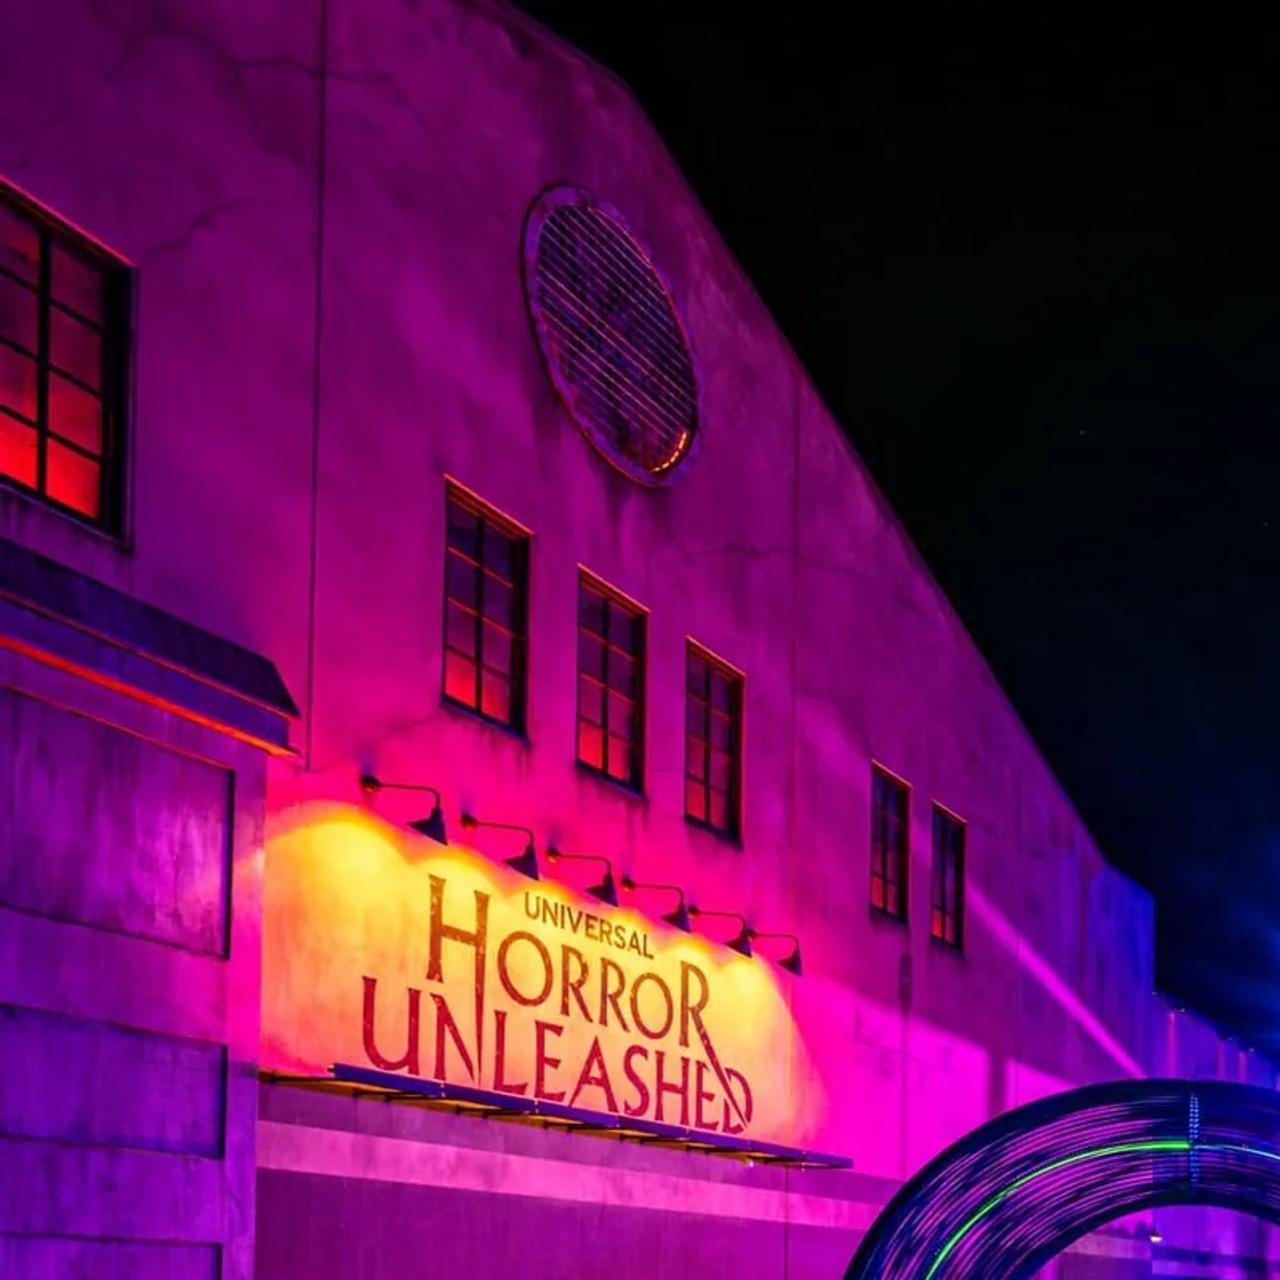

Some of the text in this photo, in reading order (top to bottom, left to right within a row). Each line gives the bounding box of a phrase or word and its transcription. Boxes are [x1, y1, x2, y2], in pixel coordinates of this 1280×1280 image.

[426, 874, 748, 1130] HORROR
[524, 892, 655, 960] UNIVERSAL
[361, 976, 753, 1135] UNLEASHED
